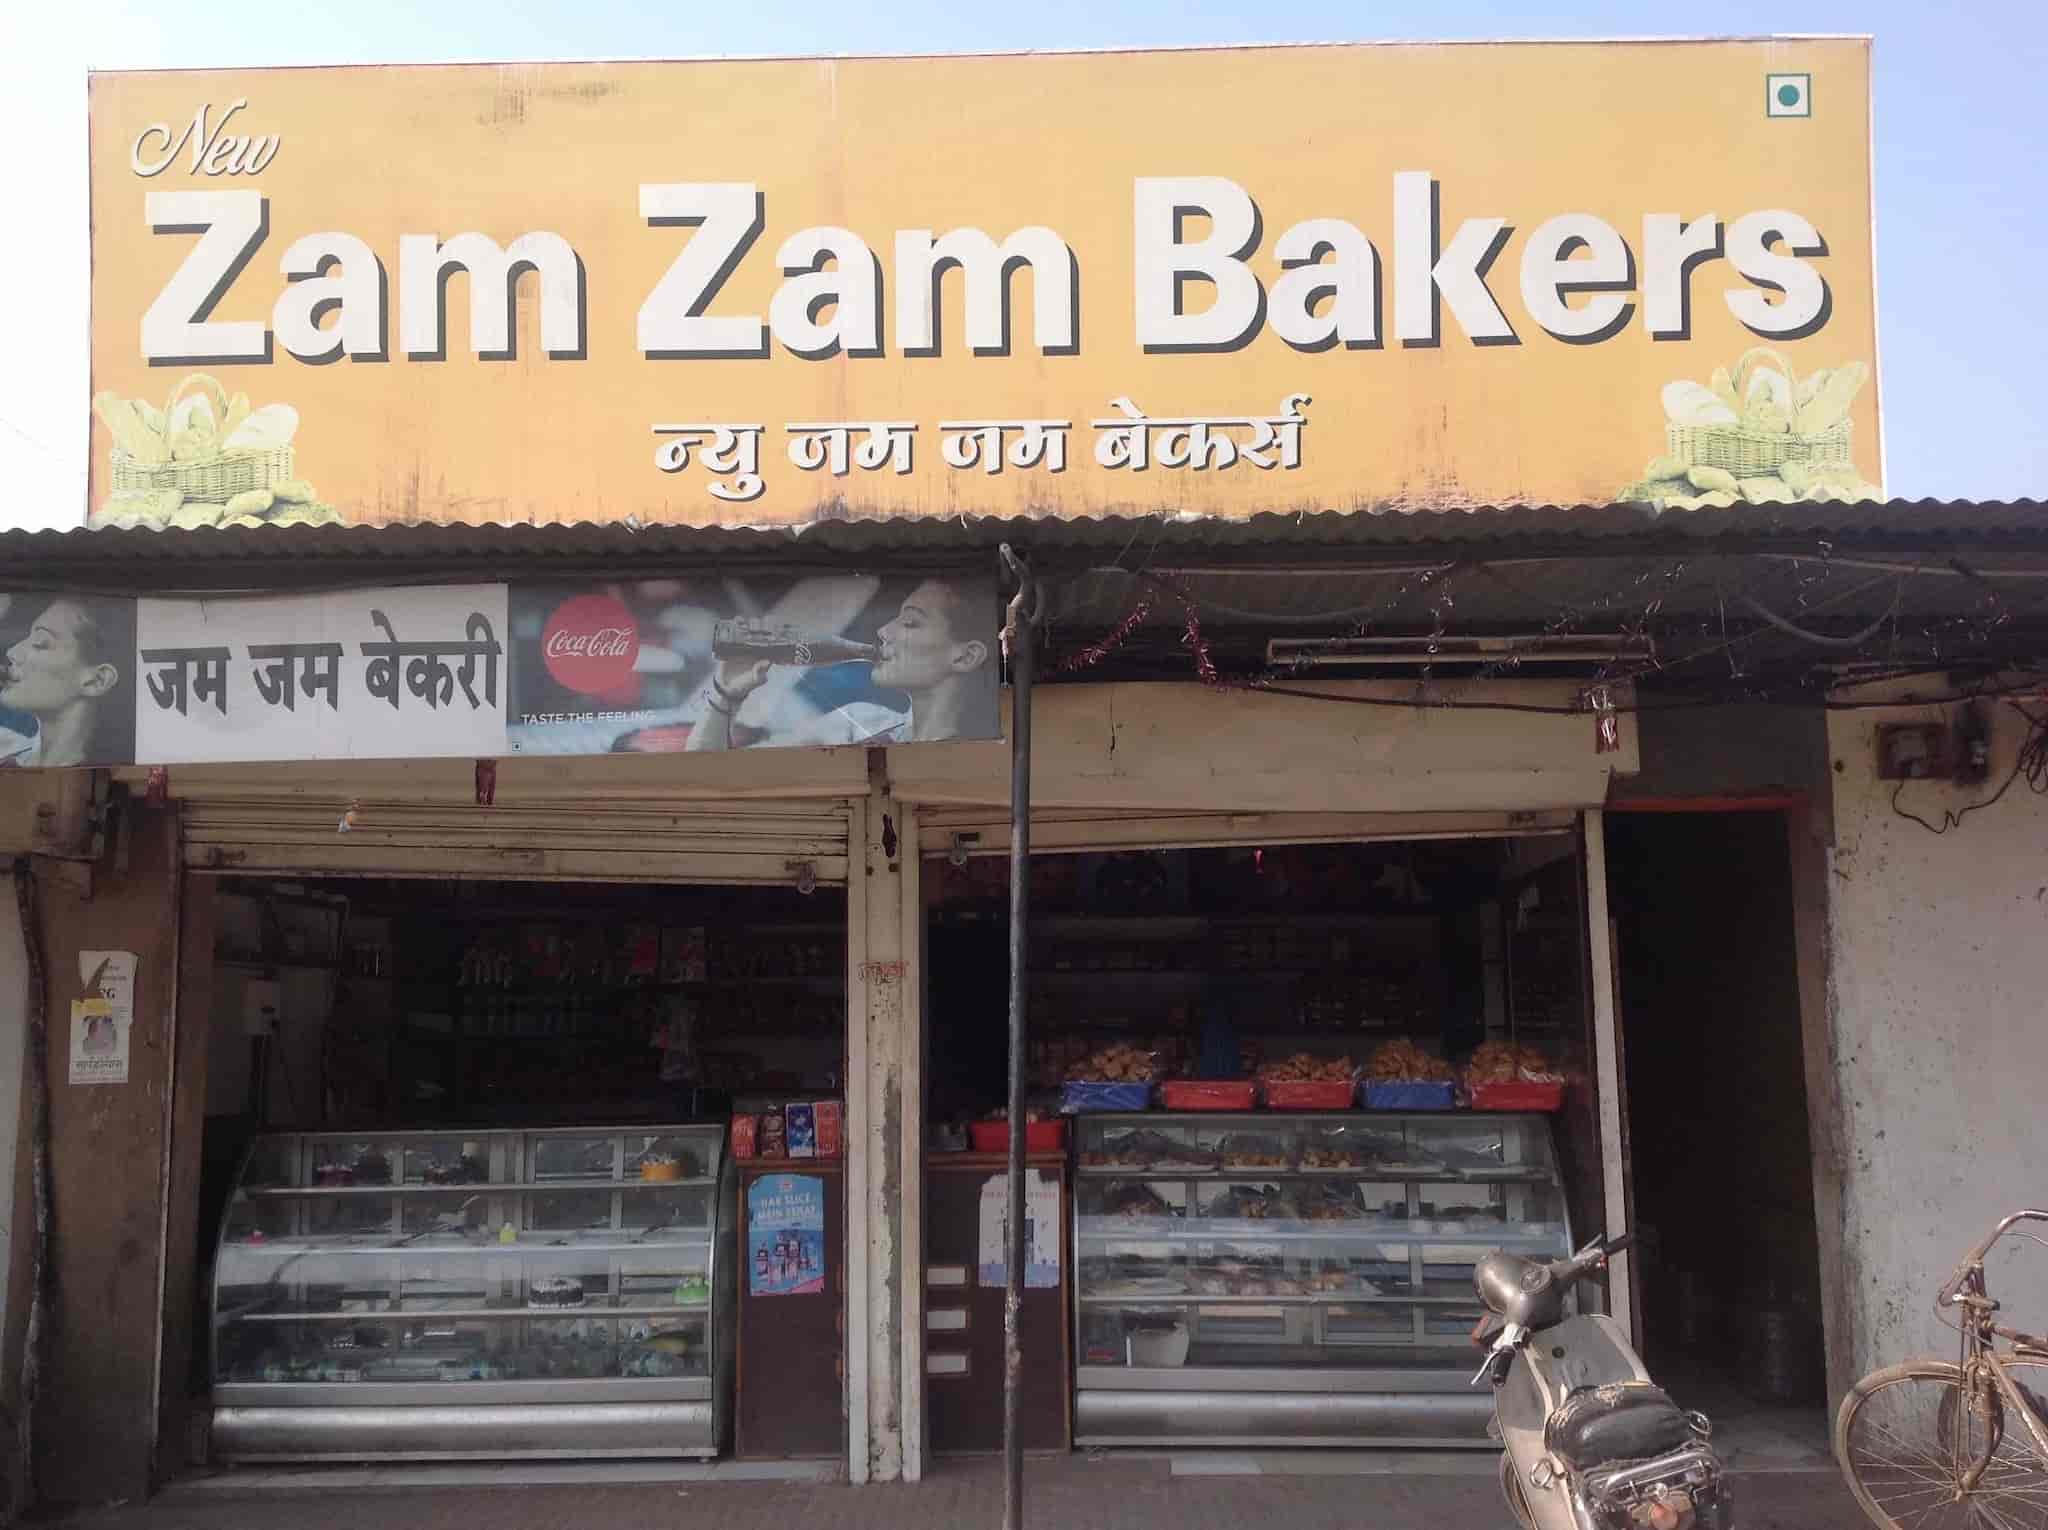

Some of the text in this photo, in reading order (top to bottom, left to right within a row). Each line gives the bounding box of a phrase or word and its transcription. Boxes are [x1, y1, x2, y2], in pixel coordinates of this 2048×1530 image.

[130, 97, 281, 177] New
[140, 171, 1832, 367] Zam Zam Bakers
[651, 393, 1312, 501] न्यु जम जम बेकर्स
[140, 609, 503, 717] जम जम बेकरी
[547, 627, 632, 657] Coca-Cola
[521, 709, 656, 725] TASTE THE FEELING
